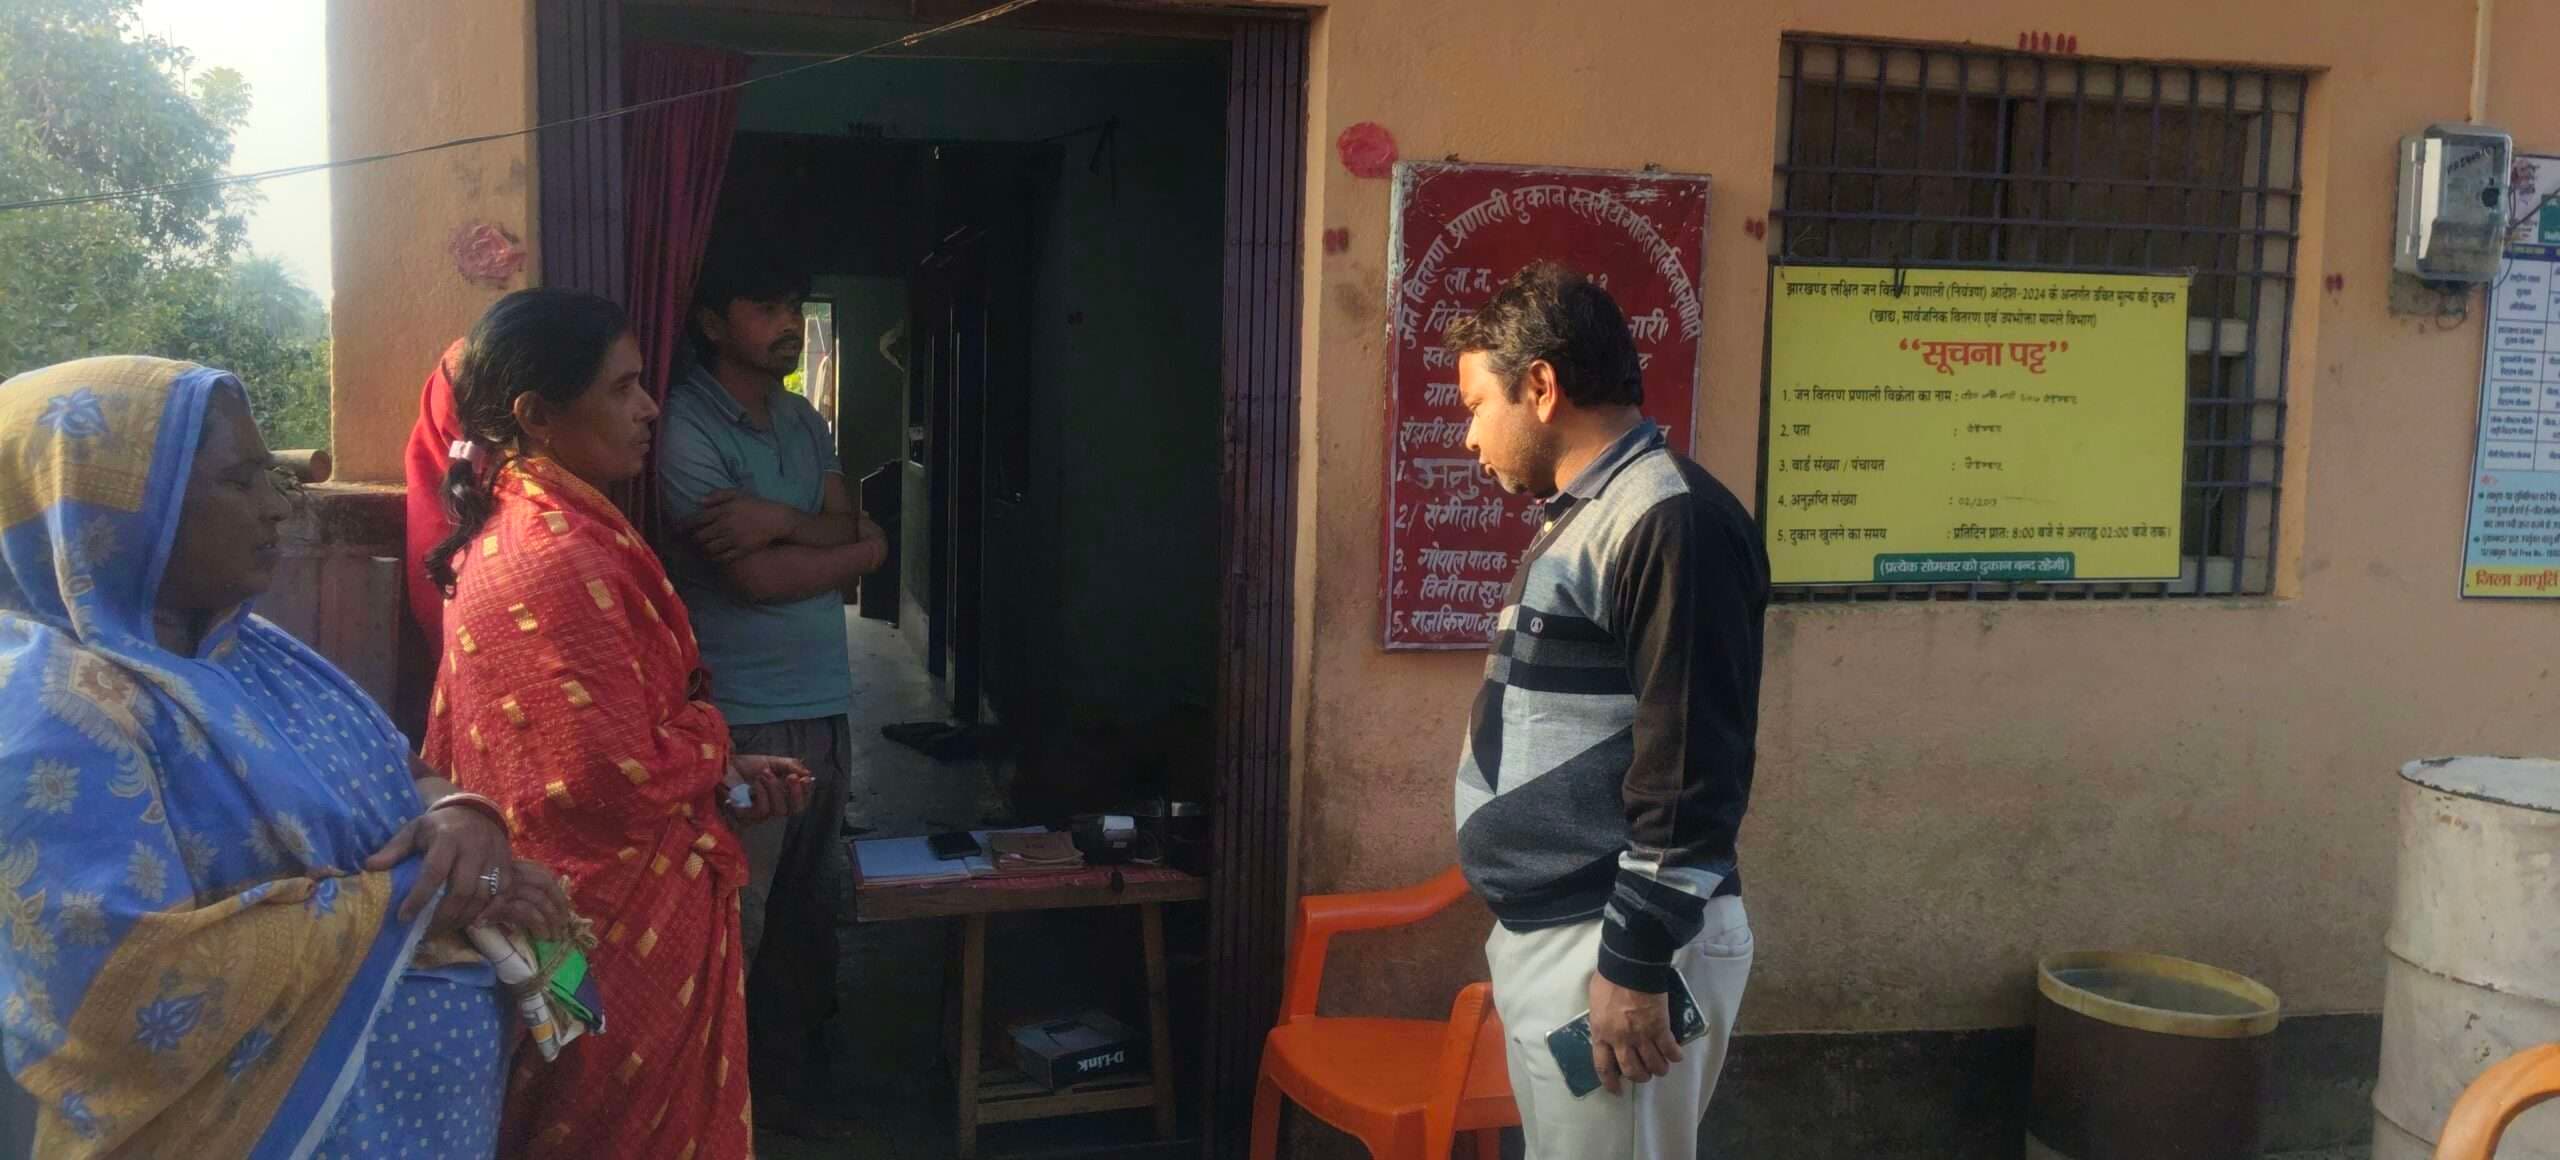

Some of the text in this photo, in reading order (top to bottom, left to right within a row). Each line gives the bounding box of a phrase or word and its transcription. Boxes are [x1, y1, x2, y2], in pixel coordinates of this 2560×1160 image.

[1403, 234, 1453, 303] वितरण
[1444, 188, 1512, 248] प्रणाली
[1512, 185, 1567, 224] दुकान
[1830, 279, 1858, 298] लक्षित
[1861, 284, 1876, 297] जन
[1913, 281, 1945, 298] प्रणाली
[1950, 307, 1981, 323] वितरण
[1794, 388, 1810, 401] जन
[1812, 385, 1846, 401] वितरण
[1848, 385, 1882, 401] प्रणाली
[1918, 389, 1932, 401] का
[1935, 390, 1953, 401] नाम
[1793, 424, 1811, 436] पता
[1814, 456, 1840, 472] संख्या
[1851, 456, 1885, 472] पंचायत
[1831, 490, 1857, 506] संख्या
[1424, 496, 1478, 531] संगीता
[1478, 497, 1503, 533] देवी
[1789, 528, 1816, 546] दुकान
[1847, 528, 1861, 541] का
[1864, 528, 1887, 541] समय
[1418, 541, 1467, 574] गोपाल
[1077, 1050, 1125, 1073] D-Link
